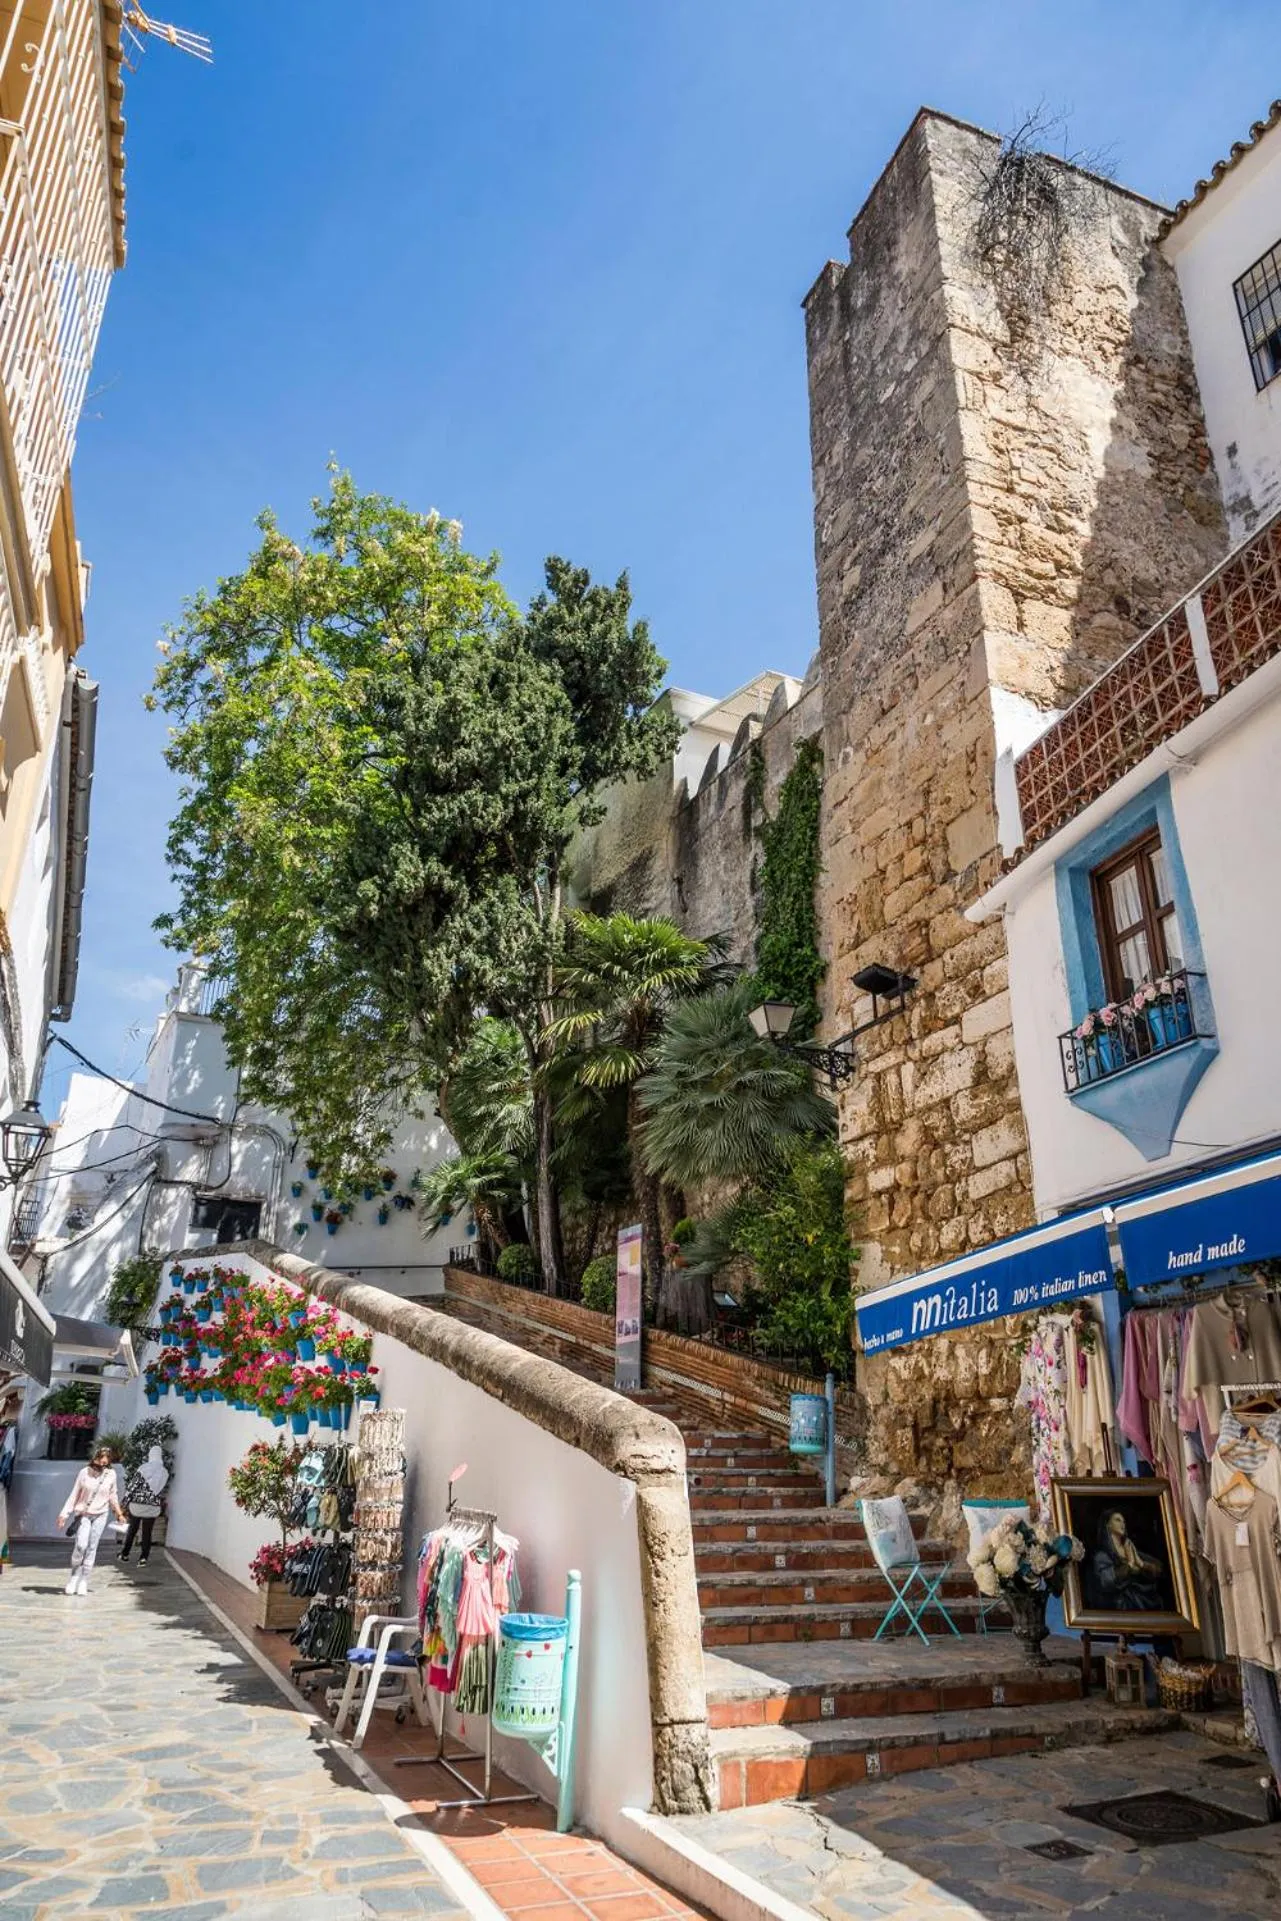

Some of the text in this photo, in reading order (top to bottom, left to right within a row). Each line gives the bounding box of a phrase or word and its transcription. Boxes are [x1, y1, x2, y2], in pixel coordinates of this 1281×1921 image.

[1167, 1233, 1246, 1270] hand made
[1041, 1277, 1076, 1298] italian
[1078, 1269, 1107, 1289] linen
